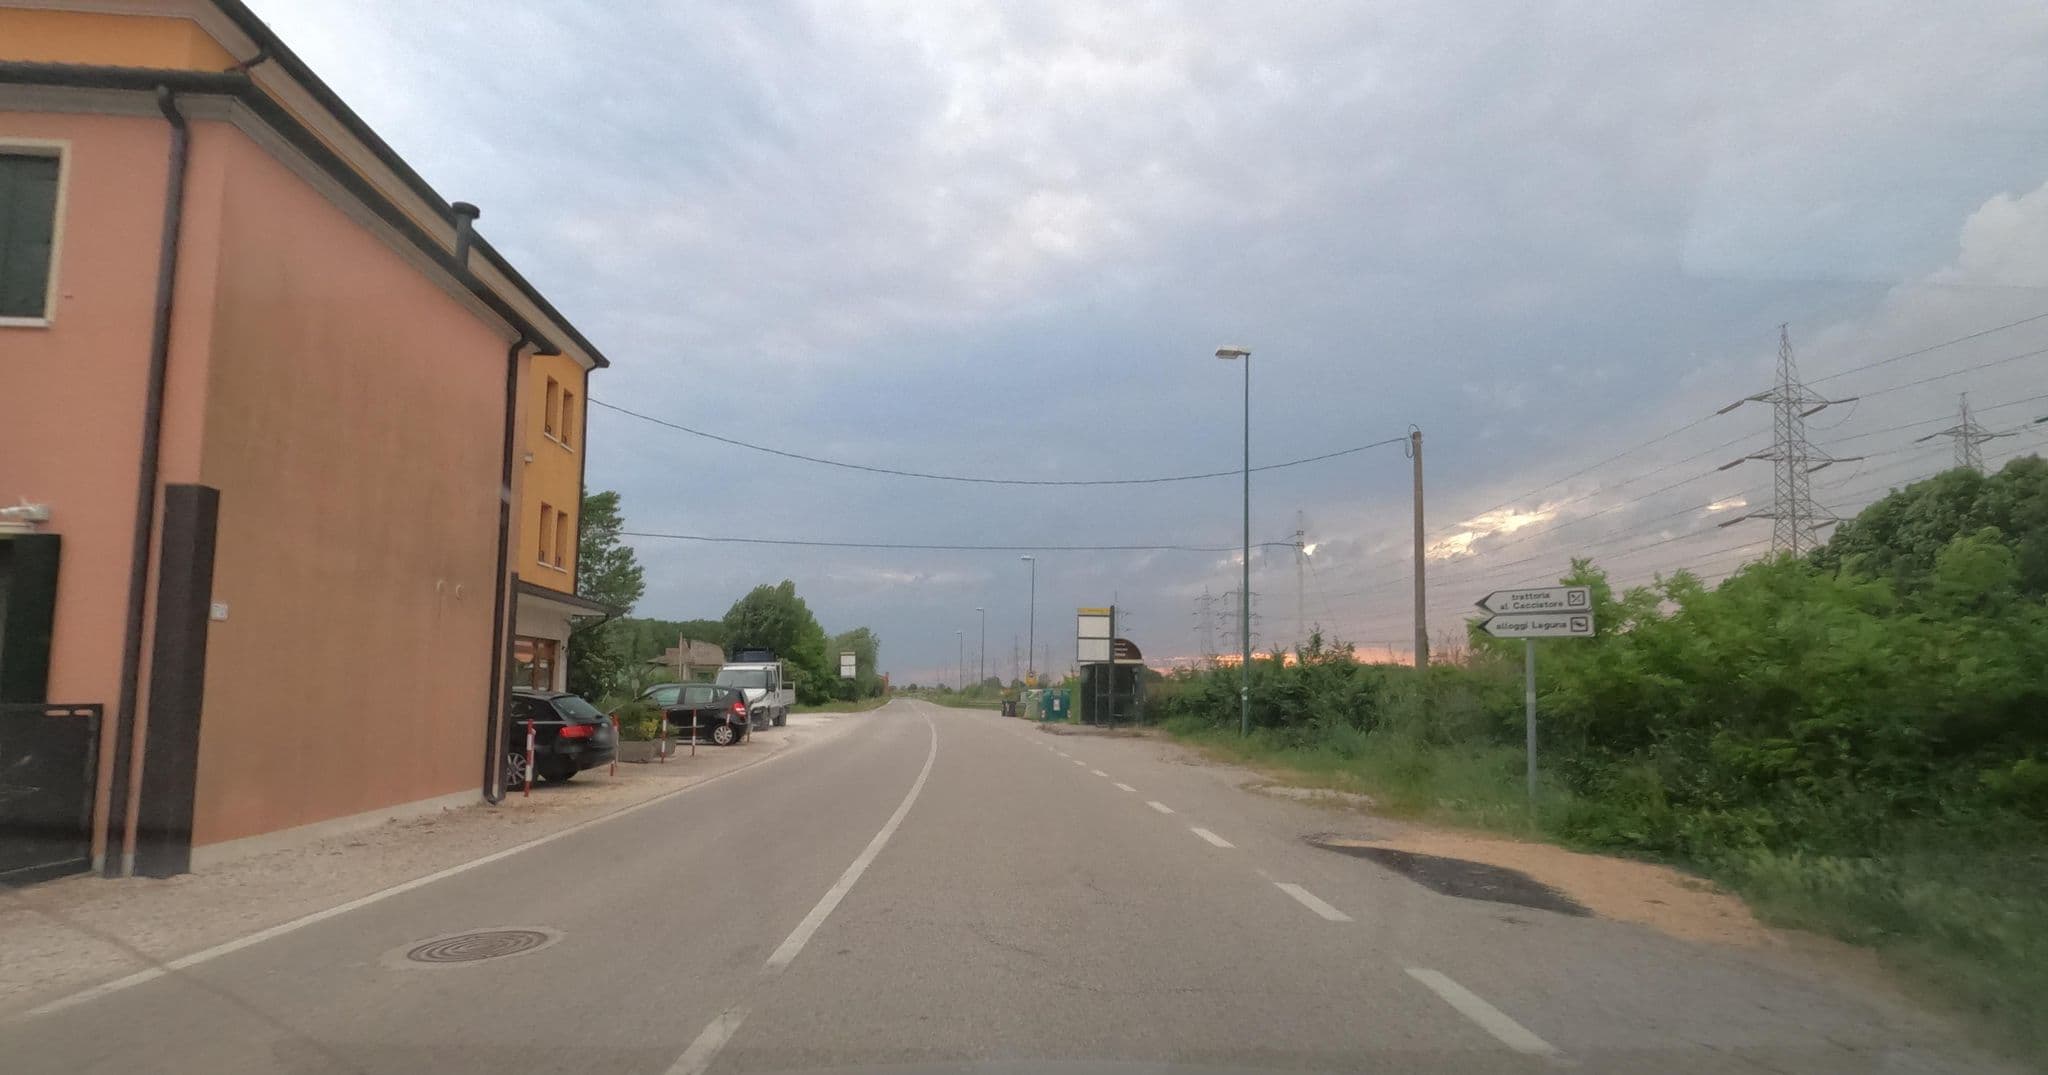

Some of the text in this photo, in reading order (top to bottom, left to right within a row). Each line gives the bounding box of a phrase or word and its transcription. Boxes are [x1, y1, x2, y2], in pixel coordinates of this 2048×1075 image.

[1512, 592, 1550, 601] trattoria
[1513, 601, 1563, 610] Cacciatore
[1496, 621, 1567, 631] alloggi Laguna
